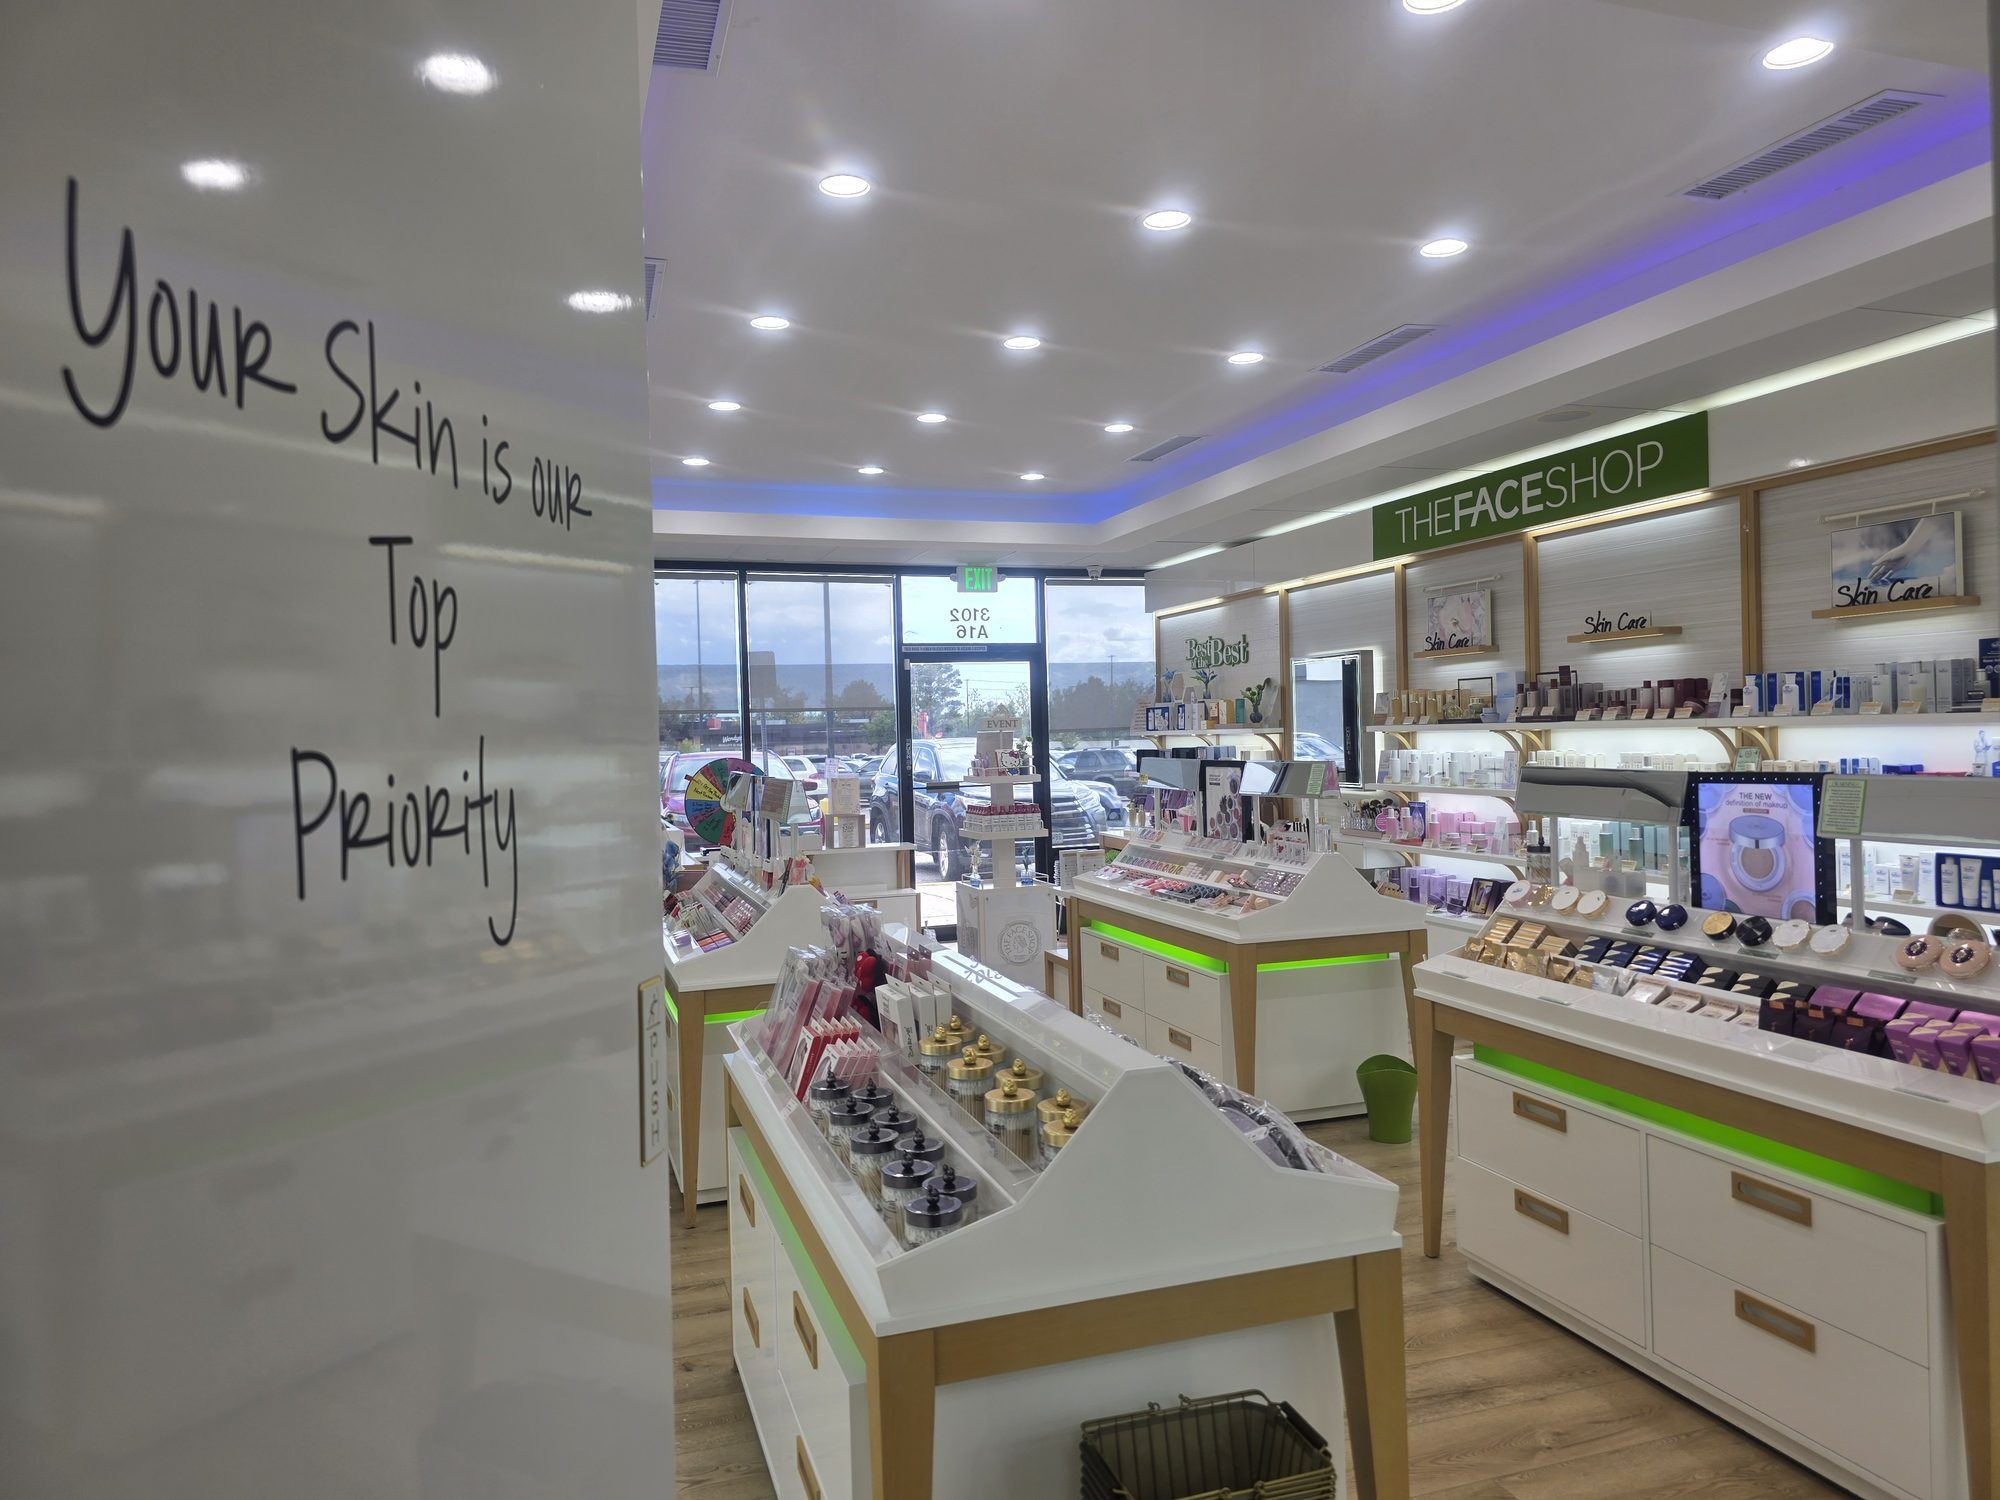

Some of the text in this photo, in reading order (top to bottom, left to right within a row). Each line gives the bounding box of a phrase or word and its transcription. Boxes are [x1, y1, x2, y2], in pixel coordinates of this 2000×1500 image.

[321, 320, 459, 489] Skin
[482, 415, 512, 504] is
[965, 567, 992, 590] EXIT
[1835, 577, 1933, 607] Skin Care
[369, 536, 458, 717] Top
[1584, 610, 1647, 634] Skin Care
[1185, 637, 1211, 660] Best
[1210, 634, 1248, 666] Best
[1425, 632, 1470, 651] Skin Care
[987, 720, 1018, 728] EVENT
[650, 1031, 660, 1147] PUSH
